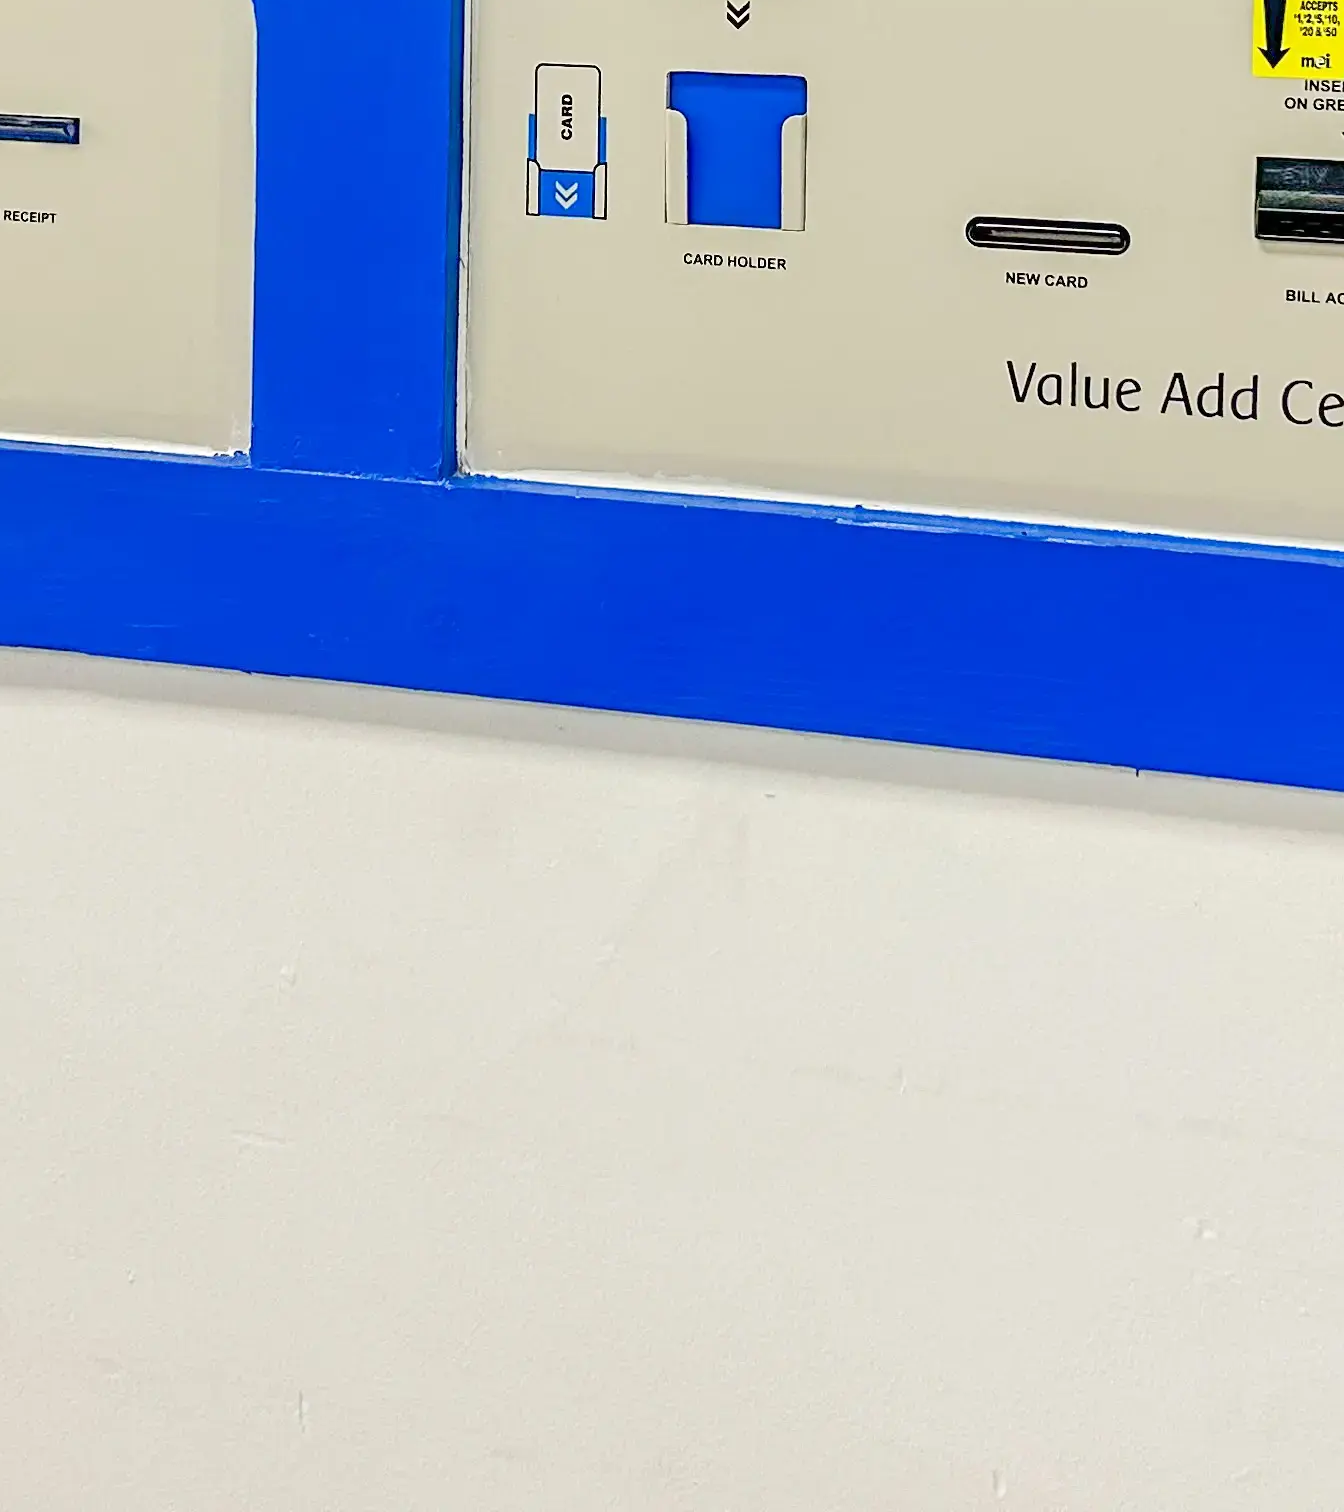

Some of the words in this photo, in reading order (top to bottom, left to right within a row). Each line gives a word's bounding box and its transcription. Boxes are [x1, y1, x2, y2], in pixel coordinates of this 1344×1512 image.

[1300, 1, 1338, 11] ACCEPTS
[1301, 53, 1332, 69] mei
[1284, 97, 1307, 110] ON
[561, 94, 573, 140] CARD
[4, 210, 57, 223] RECEIPT
[683, 253, 723, 266] CARD
[728, 256, 787, 270] HOLDER
[1006, 272, 1040, 285] NEW
[1045, 274, 1088, 288] CARD
[1286, 289, 1320, 303] BILL
[1006, 360, 1142, 412] Value
[1160, 372, 1259, 420] Add
